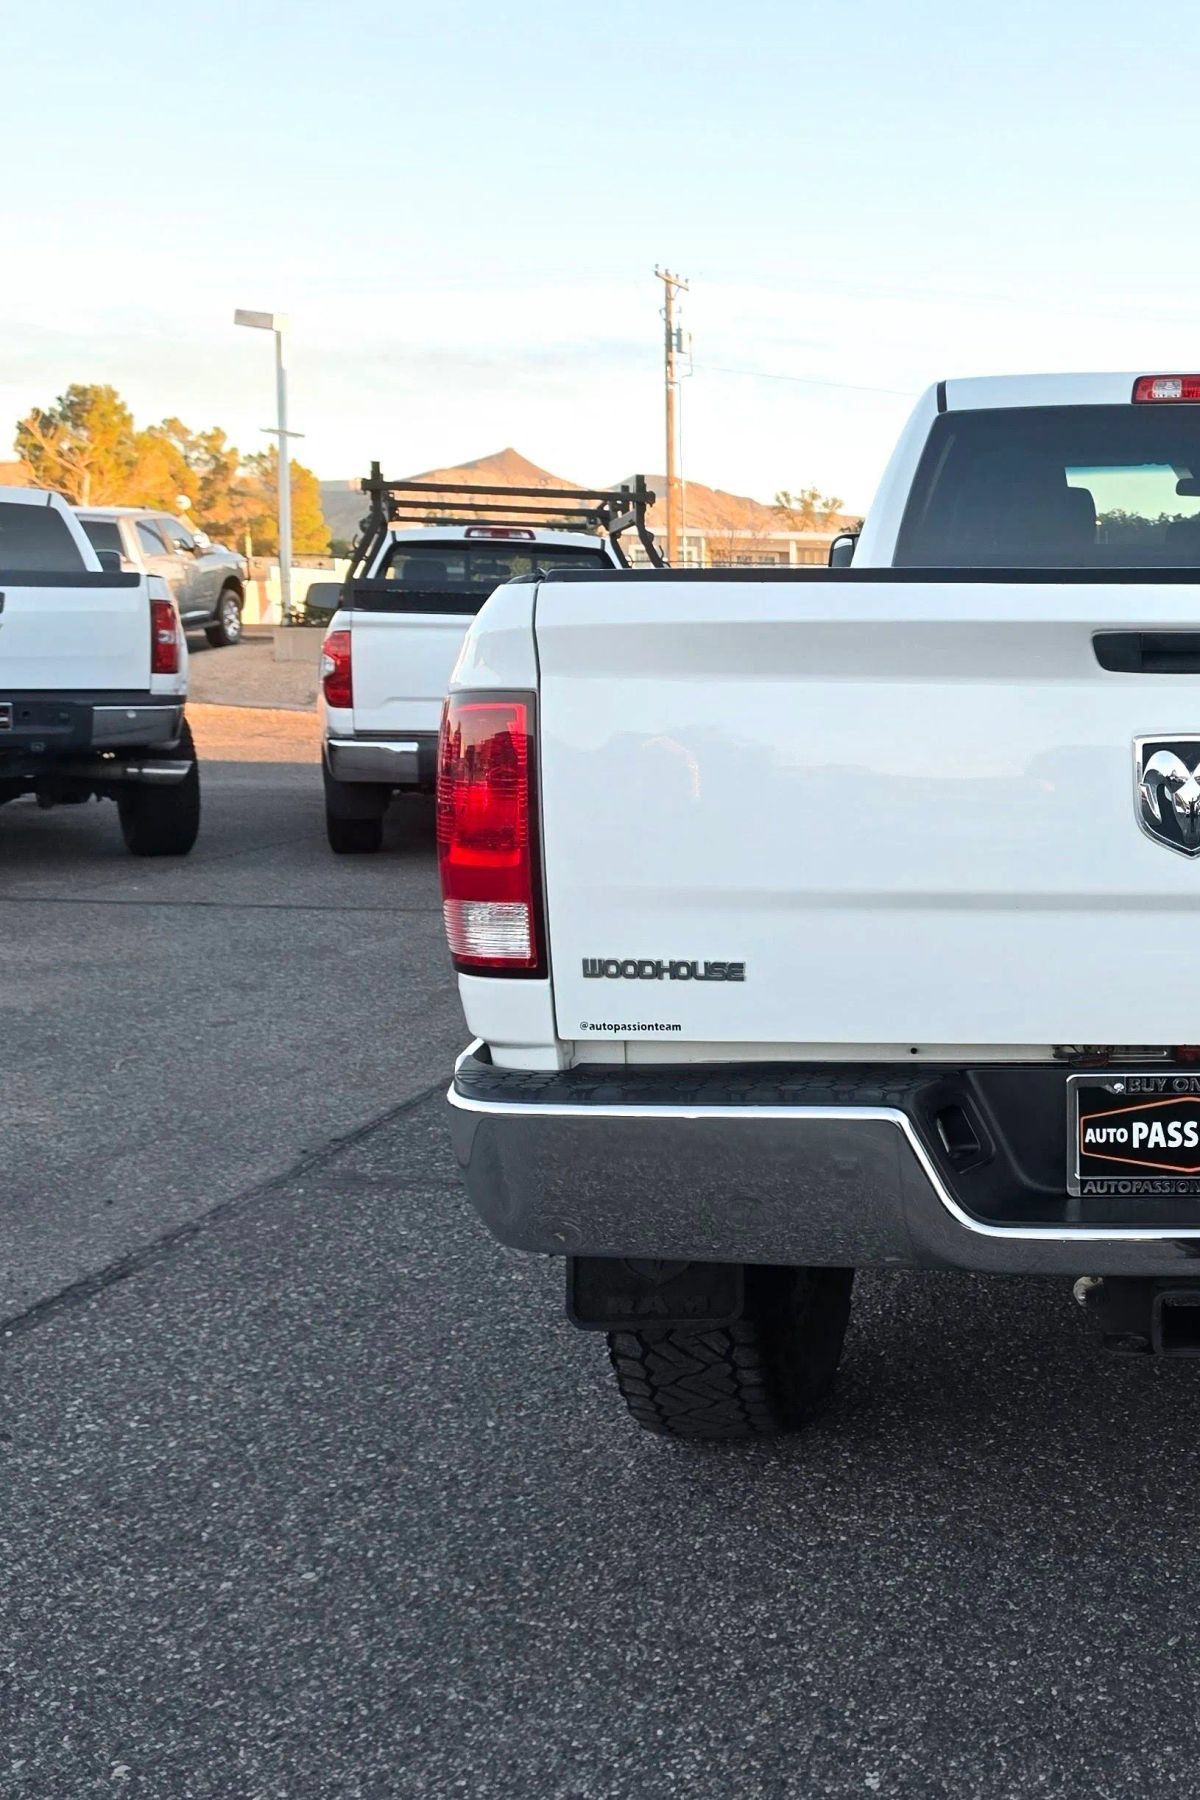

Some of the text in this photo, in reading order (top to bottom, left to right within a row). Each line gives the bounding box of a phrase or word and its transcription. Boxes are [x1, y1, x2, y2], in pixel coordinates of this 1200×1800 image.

[582, 958, 746, 982] WOODHOUSE
[579, 1021, 682, 1033] @autopassionteam
[1128, 1077, 1167, 1093] BUY
[1085, 1127, 1128, 1143] AUTO
[607, 1294, 711, 1315] RAM
